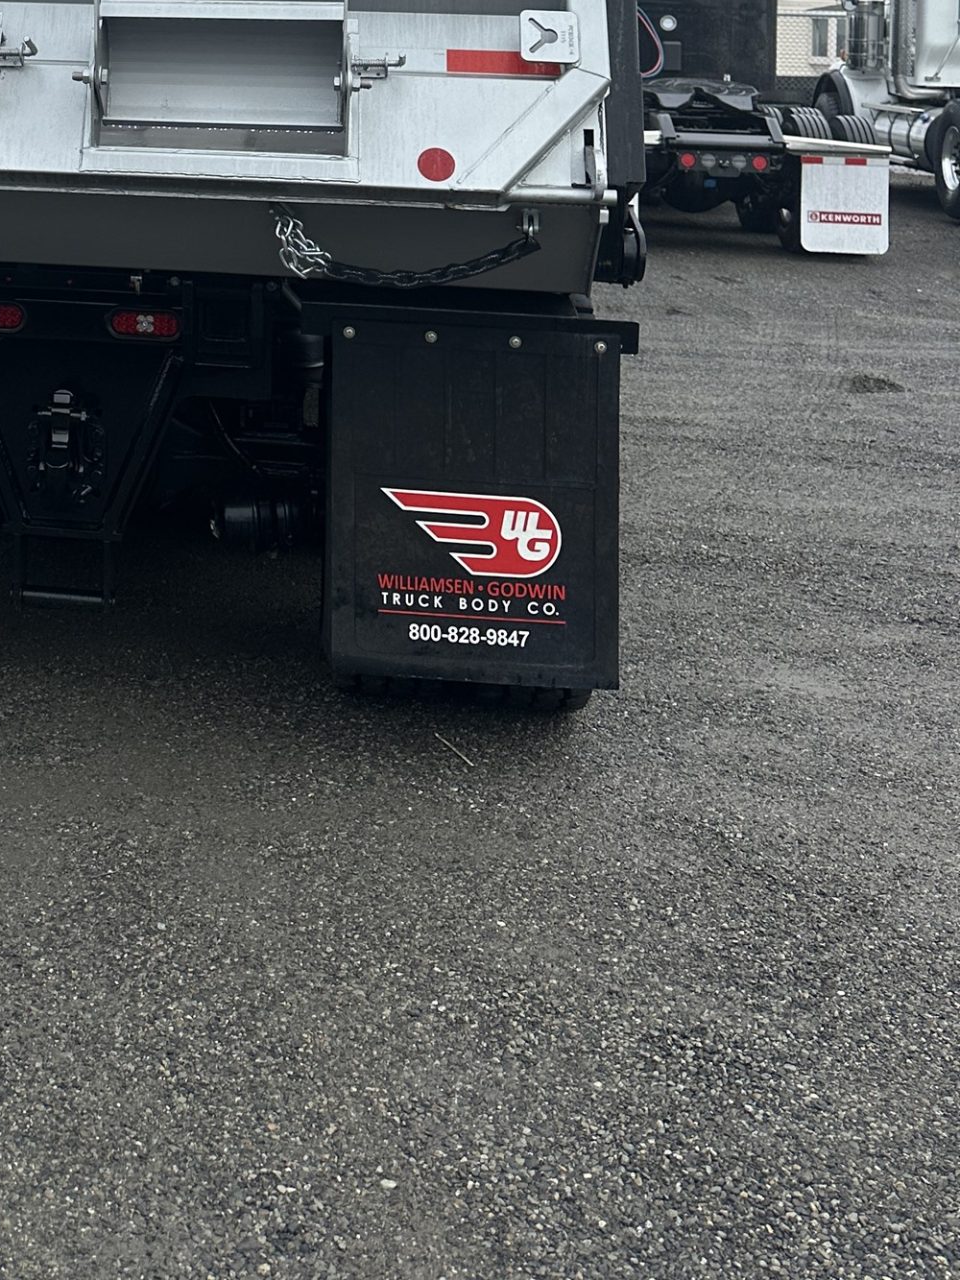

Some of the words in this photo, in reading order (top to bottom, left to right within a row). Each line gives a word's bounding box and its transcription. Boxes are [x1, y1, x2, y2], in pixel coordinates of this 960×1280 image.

[820, 213, 880, 224] KENWORTH
[377, 573, 474, 595] WILLIAMSEN
[487, 581, 566, 600] GODWIN
[381, 592, 443, 609] TRUCK
[459, 597, 511, 613] BODY
[527, 601, 560, 616] CO.
[408, 622, 530, 648] 800-828-9847
